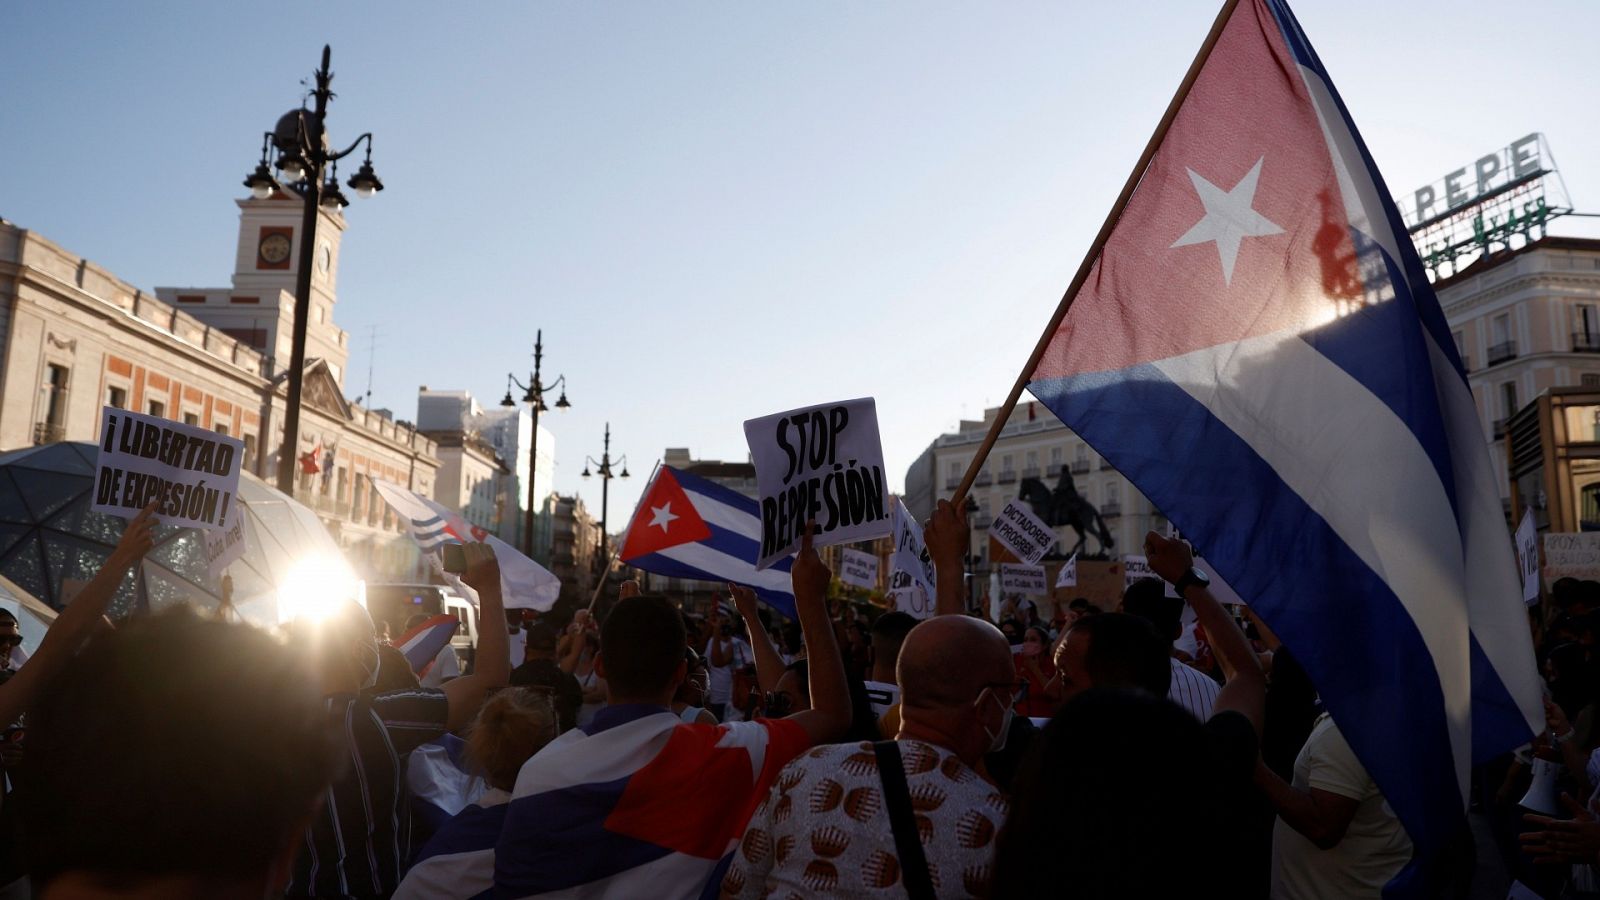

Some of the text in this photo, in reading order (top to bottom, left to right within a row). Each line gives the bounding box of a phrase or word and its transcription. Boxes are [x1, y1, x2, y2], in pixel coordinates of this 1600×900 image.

[1414, 132, 1539, 222] PEPE
[776, 406, 849, 485] STOP
[96, 466, 123, 507] DE
[1003, 566, 1043, 577] Democracia
